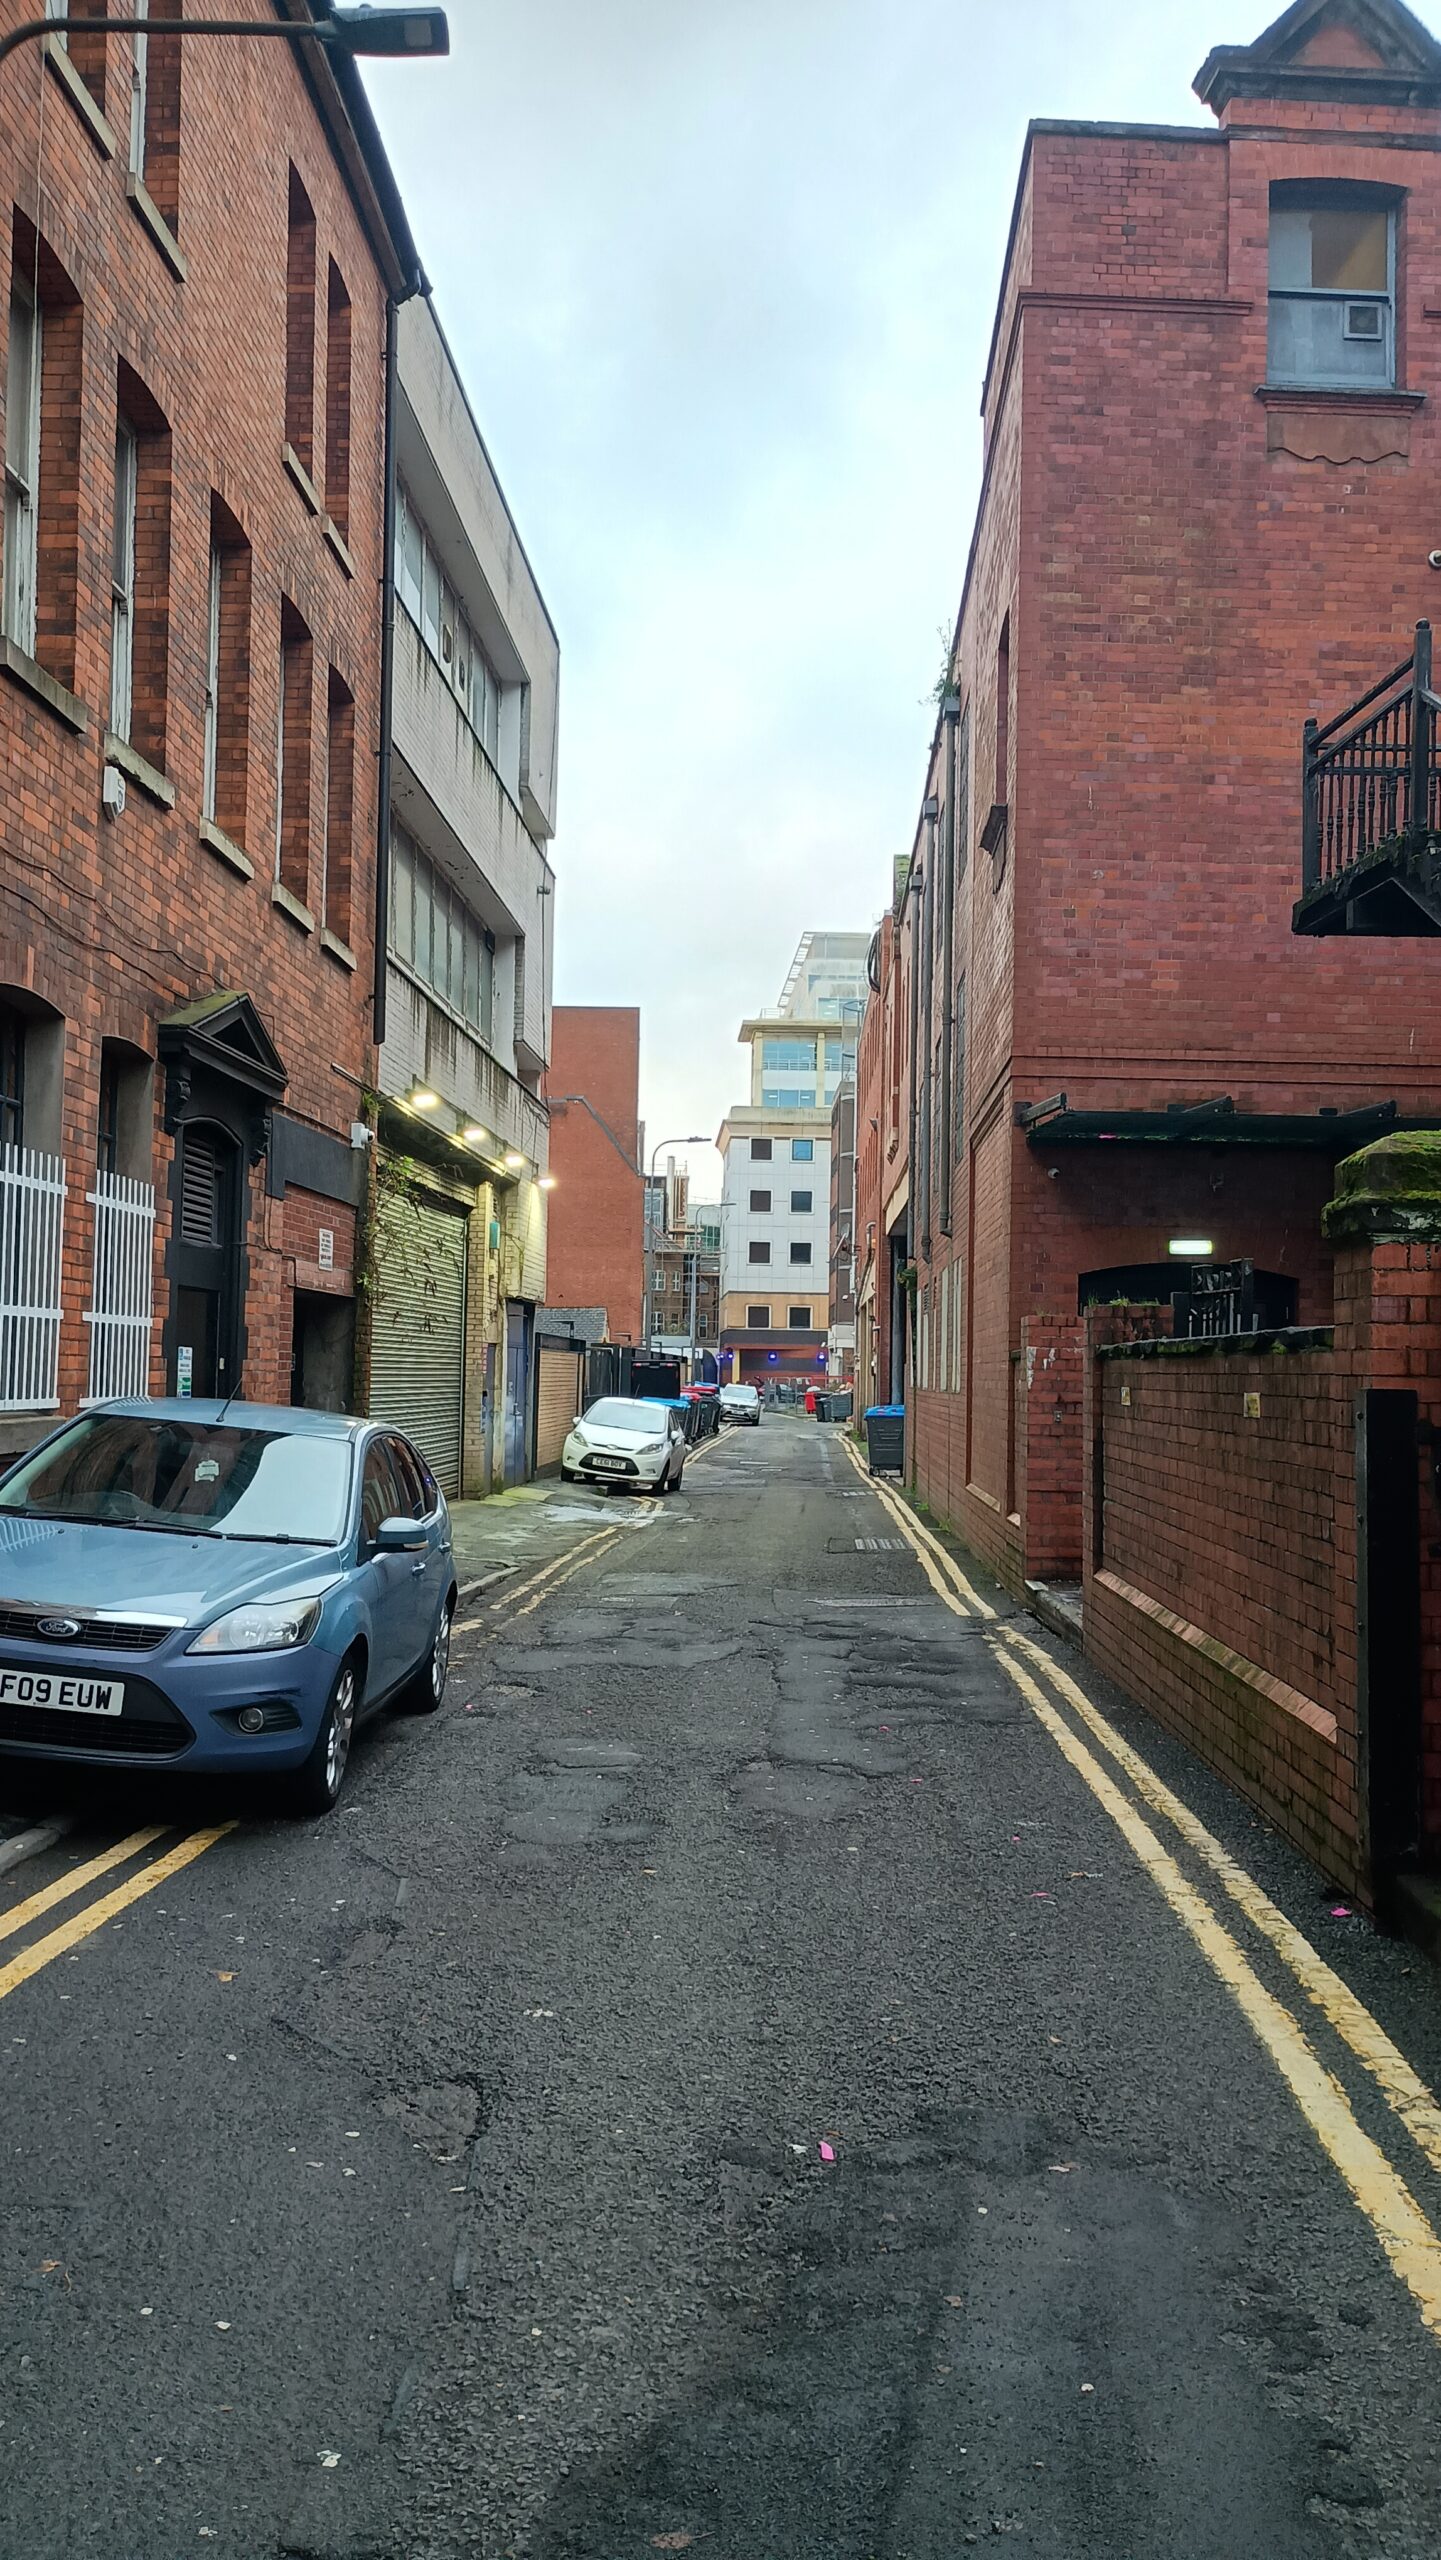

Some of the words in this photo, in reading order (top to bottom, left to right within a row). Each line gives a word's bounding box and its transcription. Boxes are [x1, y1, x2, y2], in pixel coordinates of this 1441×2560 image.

[45, 1622, 69, 1633] Ford
[0, 1674, 52, 1703] F09
[58, 1681, 113, 1710] EUW
